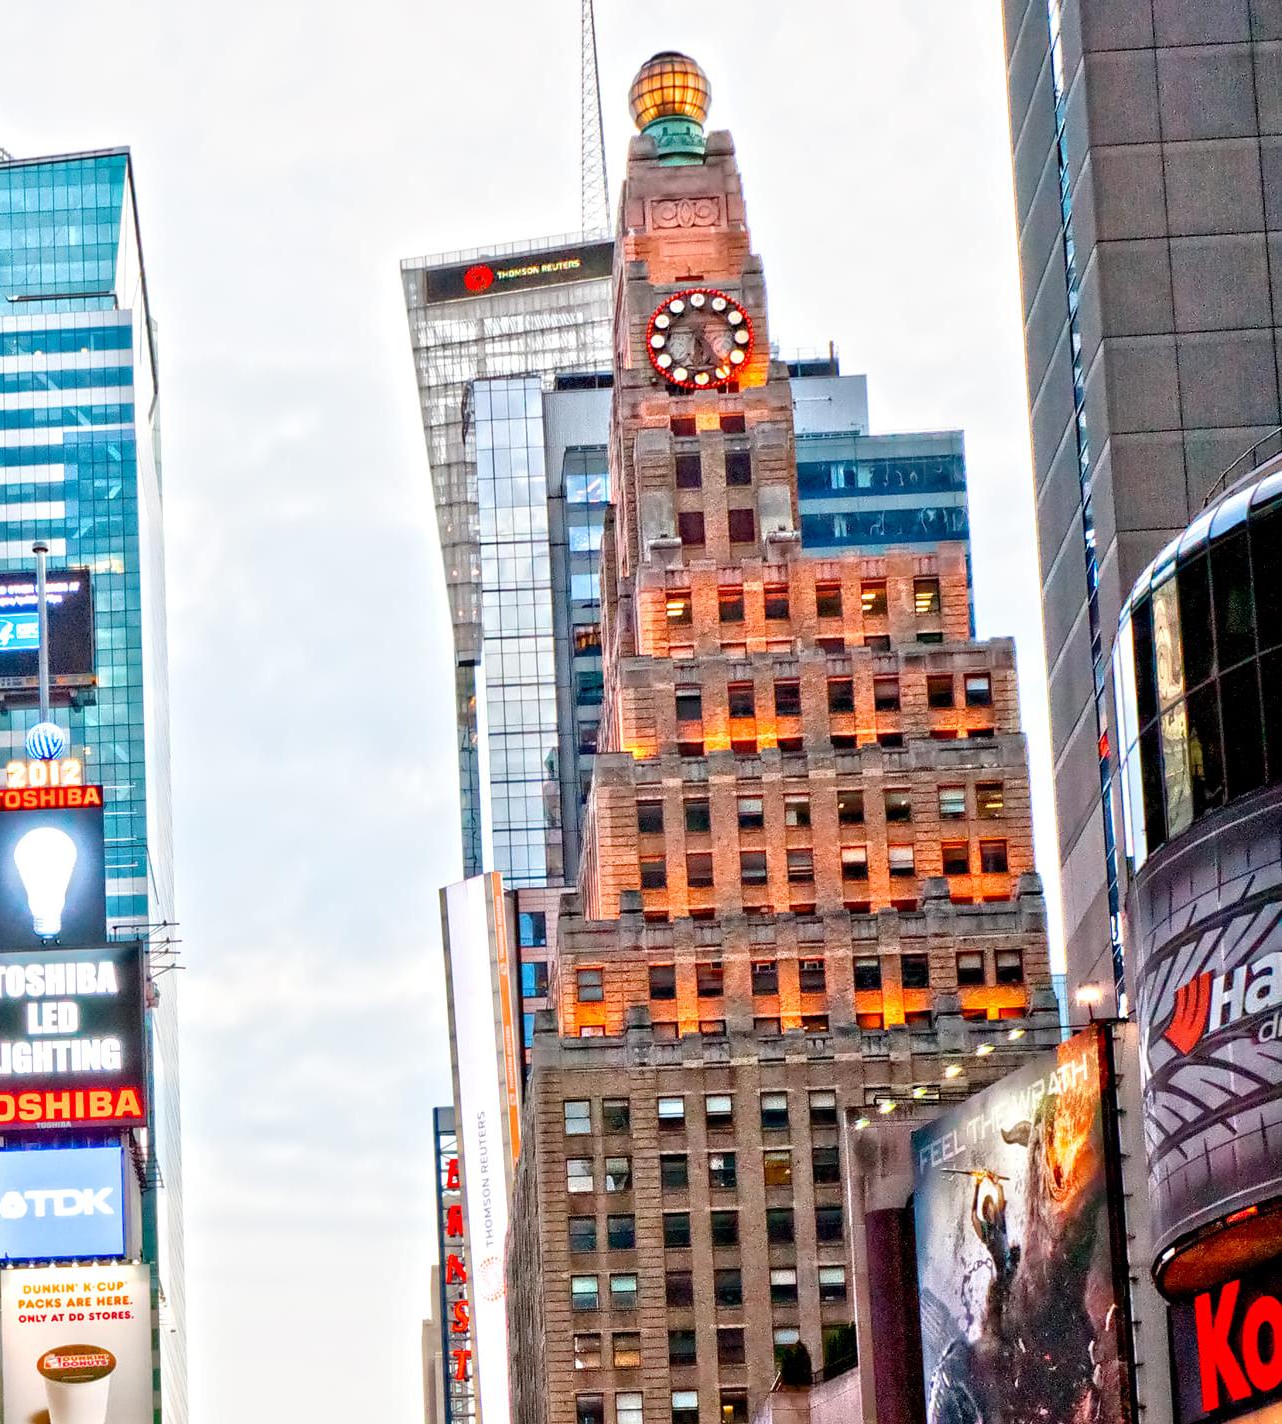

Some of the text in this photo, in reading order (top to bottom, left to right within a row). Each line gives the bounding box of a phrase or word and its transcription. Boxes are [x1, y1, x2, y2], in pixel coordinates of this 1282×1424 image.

[496, 258, 581, 280] THOMSON REUTERS
[4, 759, 84, 787] 2012
[26, 1000, 79, 1036] LED
[35, 1121, 72, 1129] TOSHIBA
[918, 1052, 1088, 1175] FEEL THE WRATH
[477, 1109, 494, 1249] THOMSON REUTERS
[24, 1186, 115, 1219] TDK
[22, 1282, 79, 1294] DUNKIN'
[18, 1295, 133, 1310] PACKS ARE HERE.
[18, 1310, 134, 1324] ONLY AT DD STORES.
[1194, 1279, 1282, 1413] Ko
[62, 1360, 109, 1368] DONUTS
